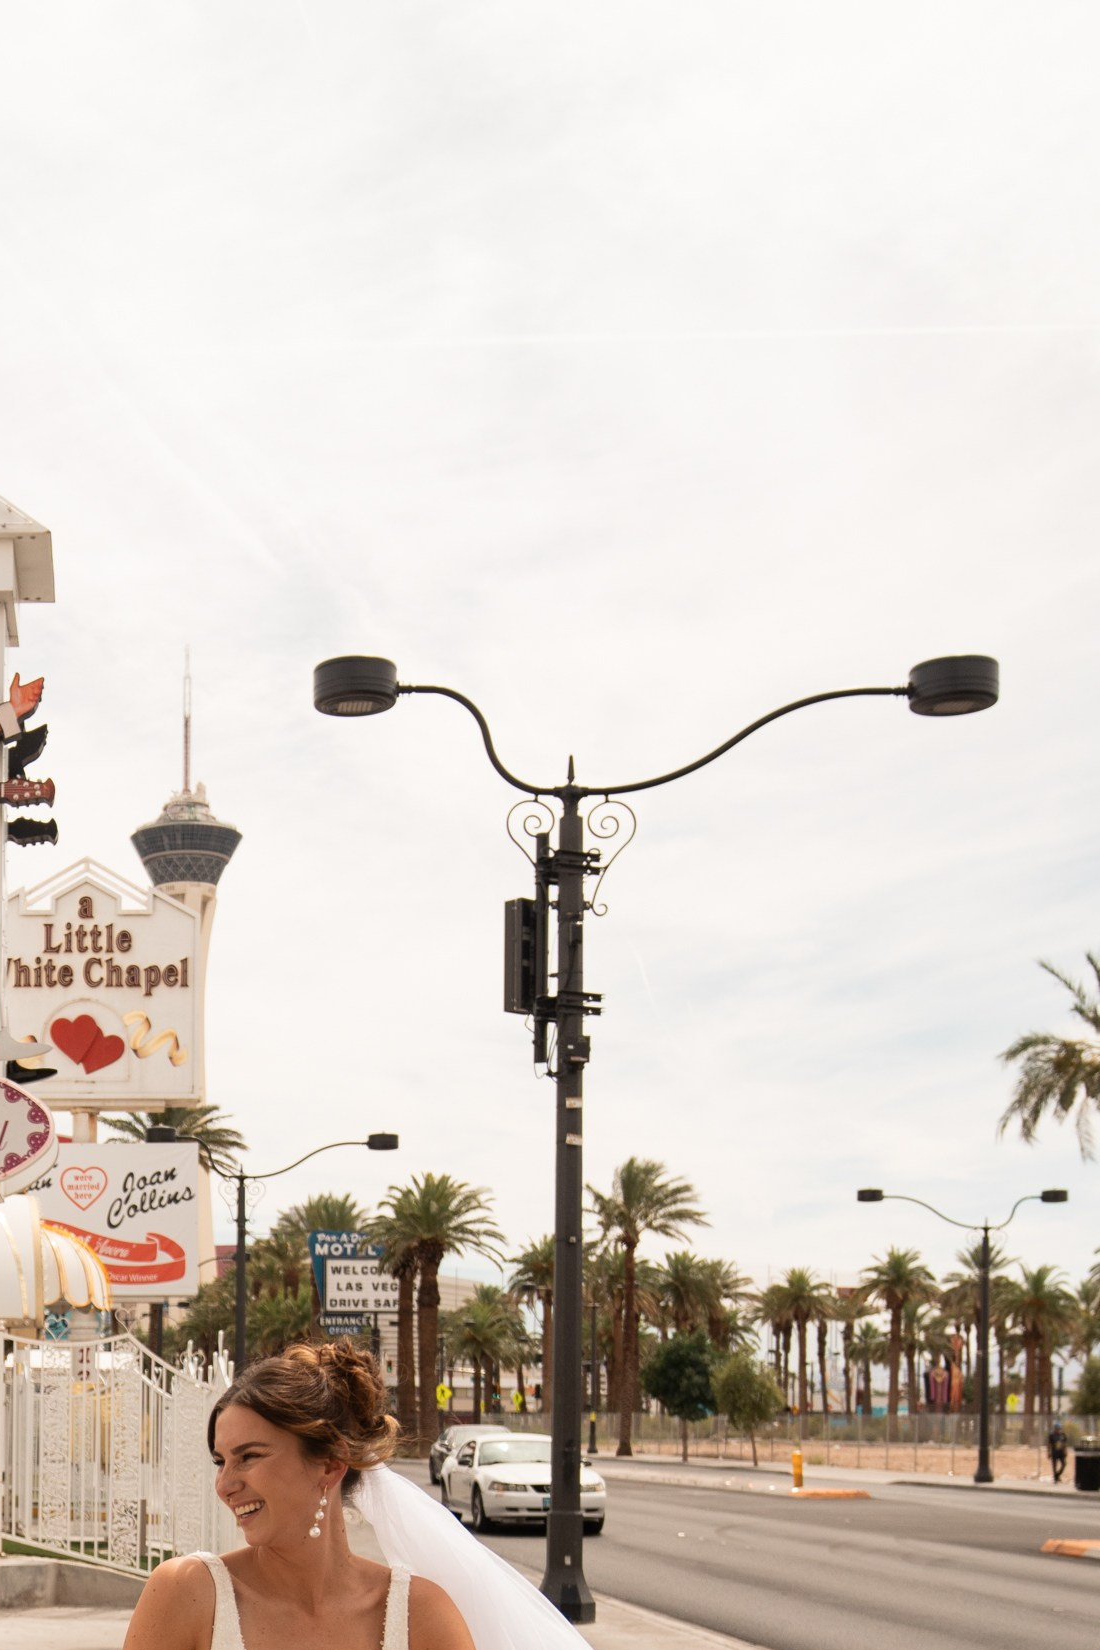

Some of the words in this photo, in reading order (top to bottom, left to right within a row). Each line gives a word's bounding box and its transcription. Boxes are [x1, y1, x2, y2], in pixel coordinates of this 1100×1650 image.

[78, 895, 94, 919] a
[43, 923, 132, 953] Little
[7, 957, 74, 988] hite
[83, 957, 189, 996] Chapel
[73, 1174, 93, 1182] were
[66, 1182, 101, 1191] married
[122, 1166, 177, 1206] Joan
[74, 1191, 93, 1200] here
[106, 1186, 196, 1229] Collins
[129, 1273, 158, 1282] Winner
[336, 1282, 363, 1292] LAS
[330, 1299, 370, 1308] DRIVE
[319, 1316, 368, 1327] ENTRANCE
